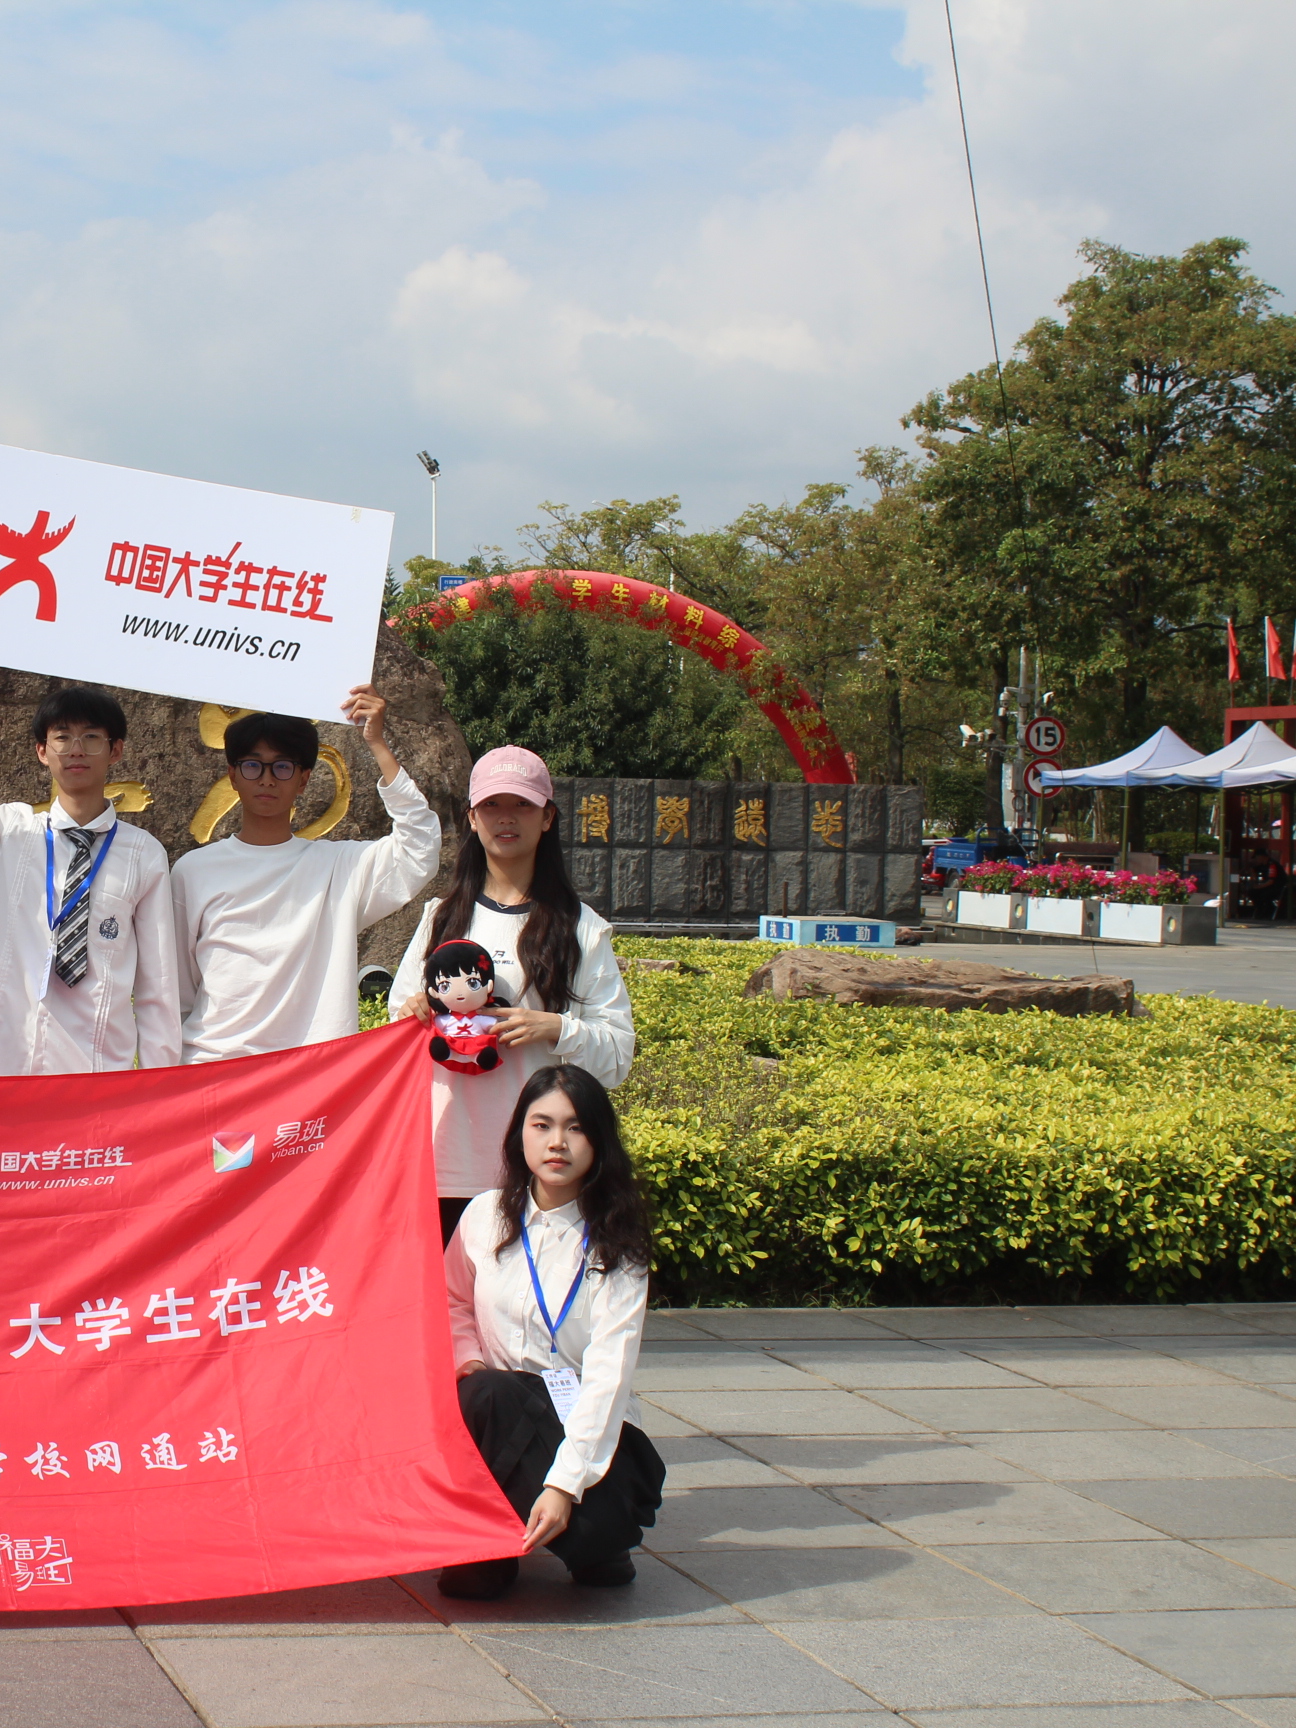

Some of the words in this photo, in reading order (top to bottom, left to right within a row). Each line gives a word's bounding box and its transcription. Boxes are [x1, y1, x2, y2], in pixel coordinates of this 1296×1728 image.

[105, 541, 333, 622] 中国大学生在线
[122, 614, 301, 662] www.univs.cn
[1035, 726, 1057, 746] 15
[490, 763, 527, 776] COLORADO
[769, 922, 790, 939] 执勤
[824, 925, 871, 941] 执勤
[273, 1116, 327, 1148] 易班
[270, 1142, 324, 1162] yiban.cn
[10, 1557, 73, 1591] 易班
